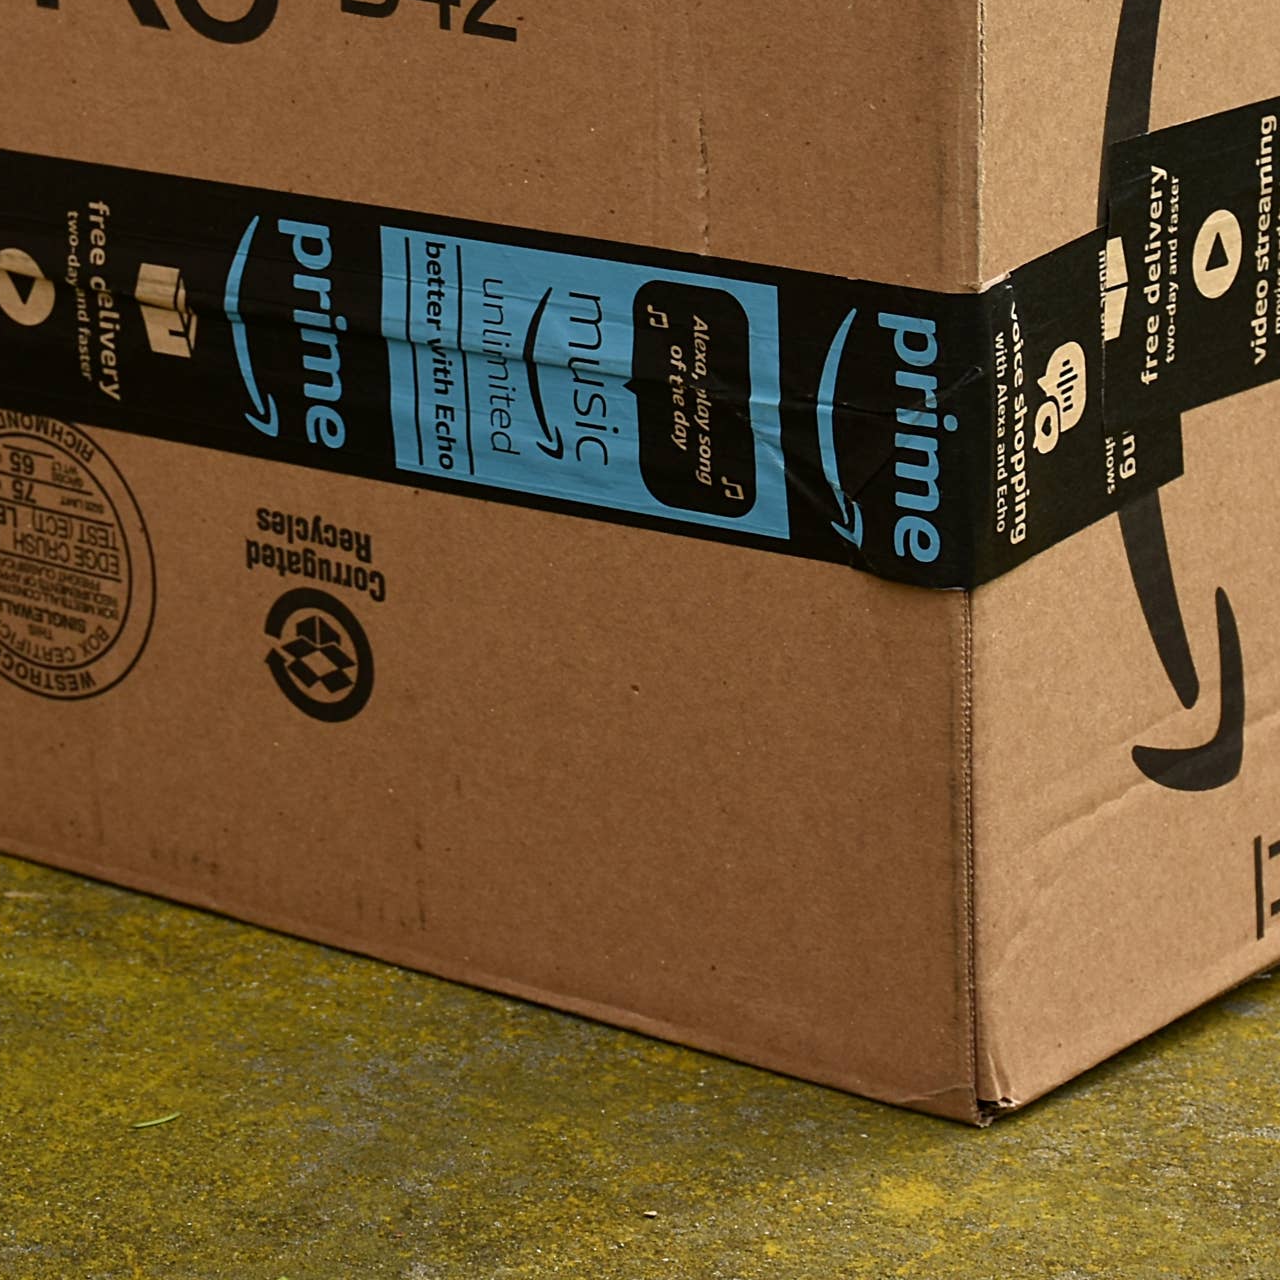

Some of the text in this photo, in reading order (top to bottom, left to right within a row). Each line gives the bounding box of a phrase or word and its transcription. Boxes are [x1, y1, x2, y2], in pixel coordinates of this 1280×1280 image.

[66, 210, 82, 288] two-day
[78, 327, 94, 382] faster
[88, 200, 121, 401] free delivery
[1140, 165, 1168, 385] free delivery
[1165, 175, 1180, 364] two-day and faster
[1251, 115, 1278, 365] video streaming
[277, 218, 348, 449] prime
[425, 240, 458, 470] better with Echo
[482, 277, 521, 457] unlimited
[568, 291, 620, 466] music
[670, 345, 687, 372] of
[688, 314, 713, 487] Alexa, play song
[9, 451, 35, 476] 65
[11, 478, 37, 505] 75
[671, 410, 691, 451] day
[877, 311, 960, 564] prime
[995, 331, 1009, 533] with Alexa and Echo
[1010, 301, 1031, 545] voice shopping
[1105, 436, 1116, 494] shows
[13, 529, 71, 564] CRUSH
[73, 544, 120, 576] EDGE
[75, 523, 120, 552] TEST
[246, 539, 387, 602] Corrugated
[256, 507, 373, 564] Recycles
[81, 625, 111, 654] BOX
